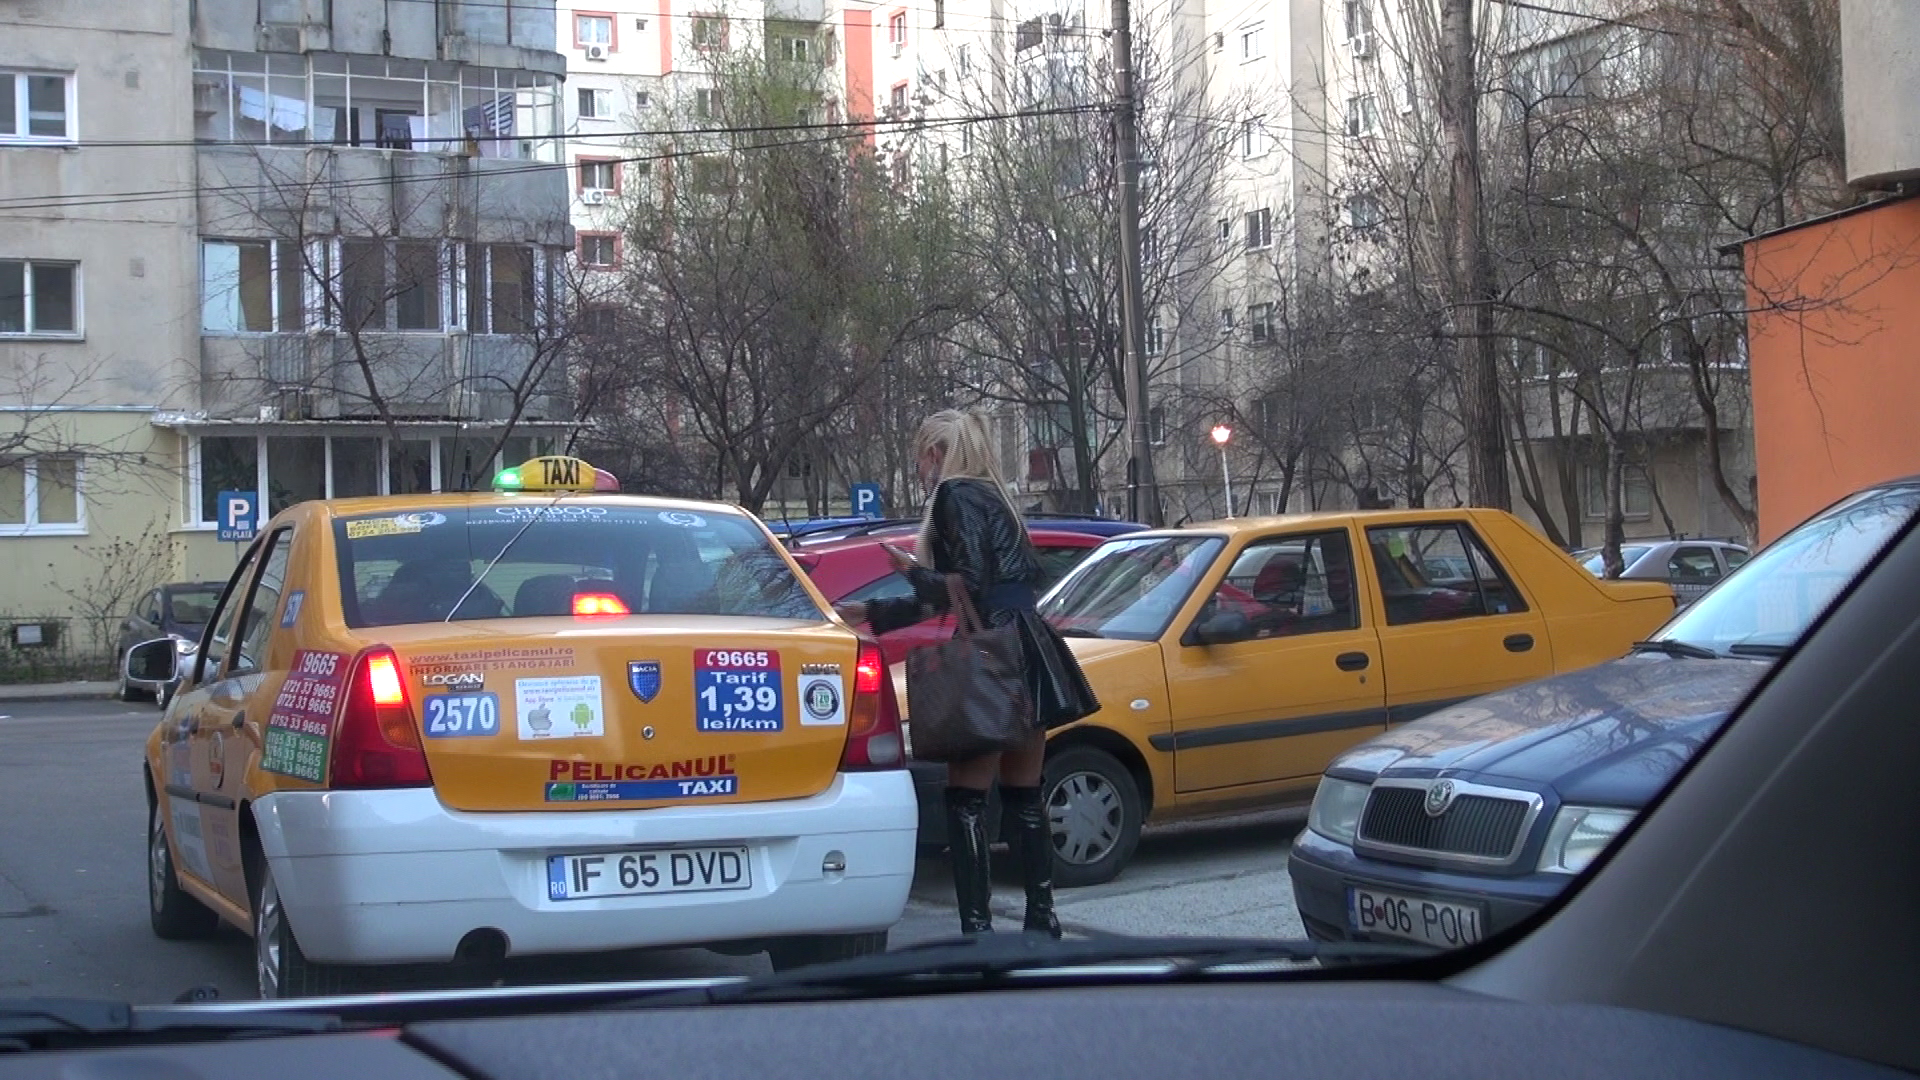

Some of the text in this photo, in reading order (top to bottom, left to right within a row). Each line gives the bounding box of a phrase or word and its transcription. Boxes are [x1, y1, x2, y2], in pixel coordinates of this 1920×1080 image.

[538, 459, 581, 485] TAXI
[858, 489, 874, 511] P
[228, 499, 250, 527] P
[496, 507, 607, 515] CHABOO
[221, 530, 232, 539] CU
[303, 652, 340, 676] 9665
[409, 648, 574, 664] www.taxipelicanul.ro
[717, 651, 769, 667] 9665
[410, 662, 489, 676] INFORMARE
[507, 659, 575, 670] ANGAJARI
[423, 672, 484, 686] LOGAN
[710, 671, 768, 684] Tarif
[301, 682, 313, 695] 33
[313, 683, 336, 699] 9665
[296, 696, 308, 711] 33
[308, 697, 333, 715] 9665
[701, 686, 777, 717] 1,39
[429, 696, 496, 733] 2570
[703, 717, 778, 729] lei/km
[289, 716, 302, 730] 33
[302, 719, 327, 736] 9665
[677, 779, 732, 796] TAXI
[571, 851, 742, 893] IF 65 DVD
[552, 882, 566, 895] RO
[1359, 892, 1376, 927] B
[1383, 896, 1412, 933] 06
